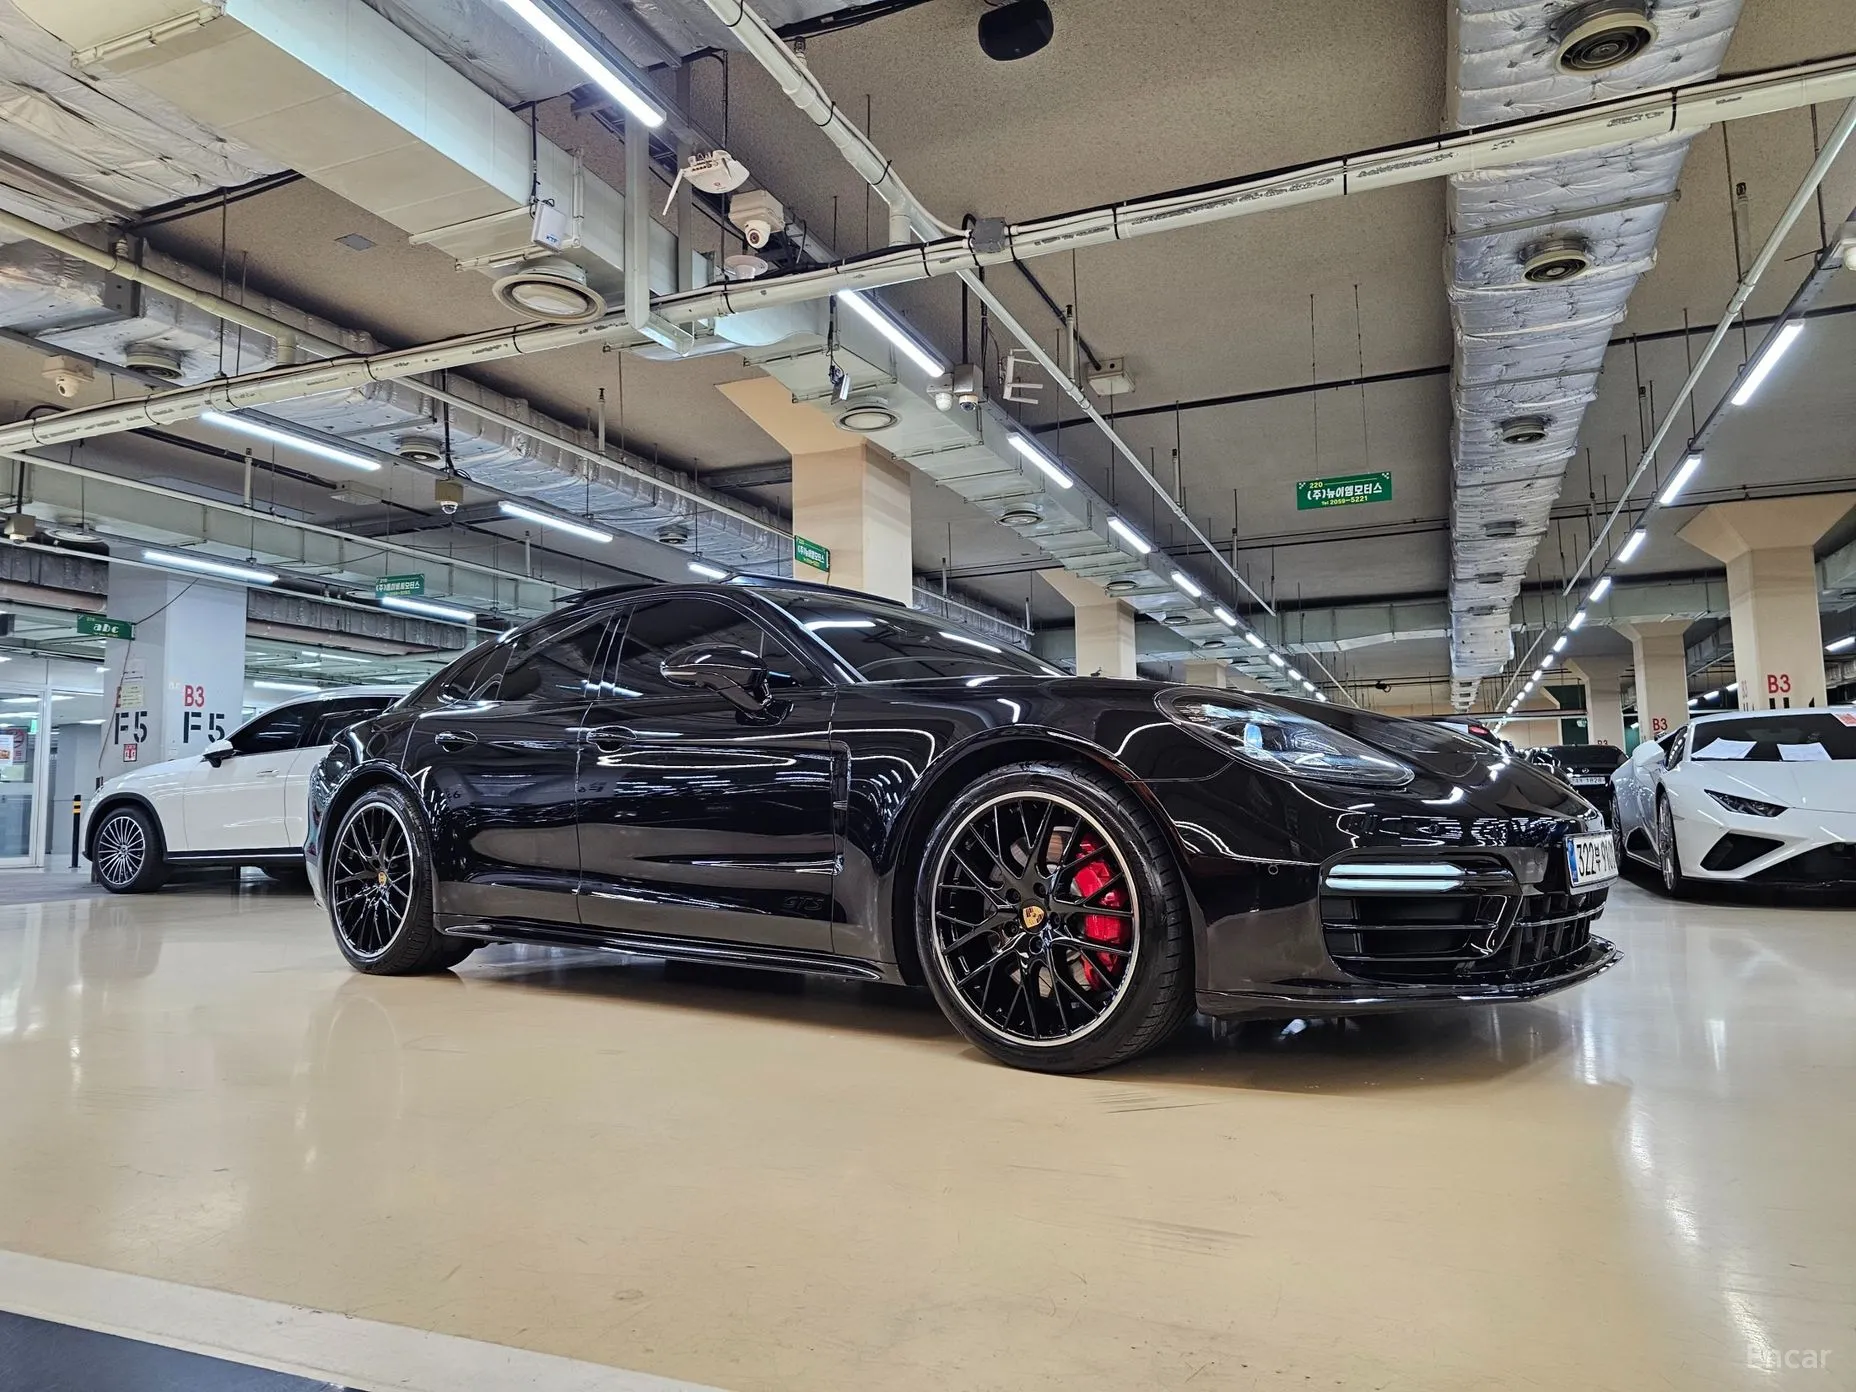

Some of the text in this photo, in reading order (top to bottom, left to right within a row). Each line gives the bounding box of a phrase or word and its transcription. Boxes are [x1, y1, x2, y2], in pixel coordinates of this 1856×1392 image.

[1309, 481, 1324, 489] 220
[1767, 674, 1791, 694] B3
[184, 684, 205, 707] B3
[1652, 718, 1668, 731] B3
[784, 895, 825, 911] GTS
